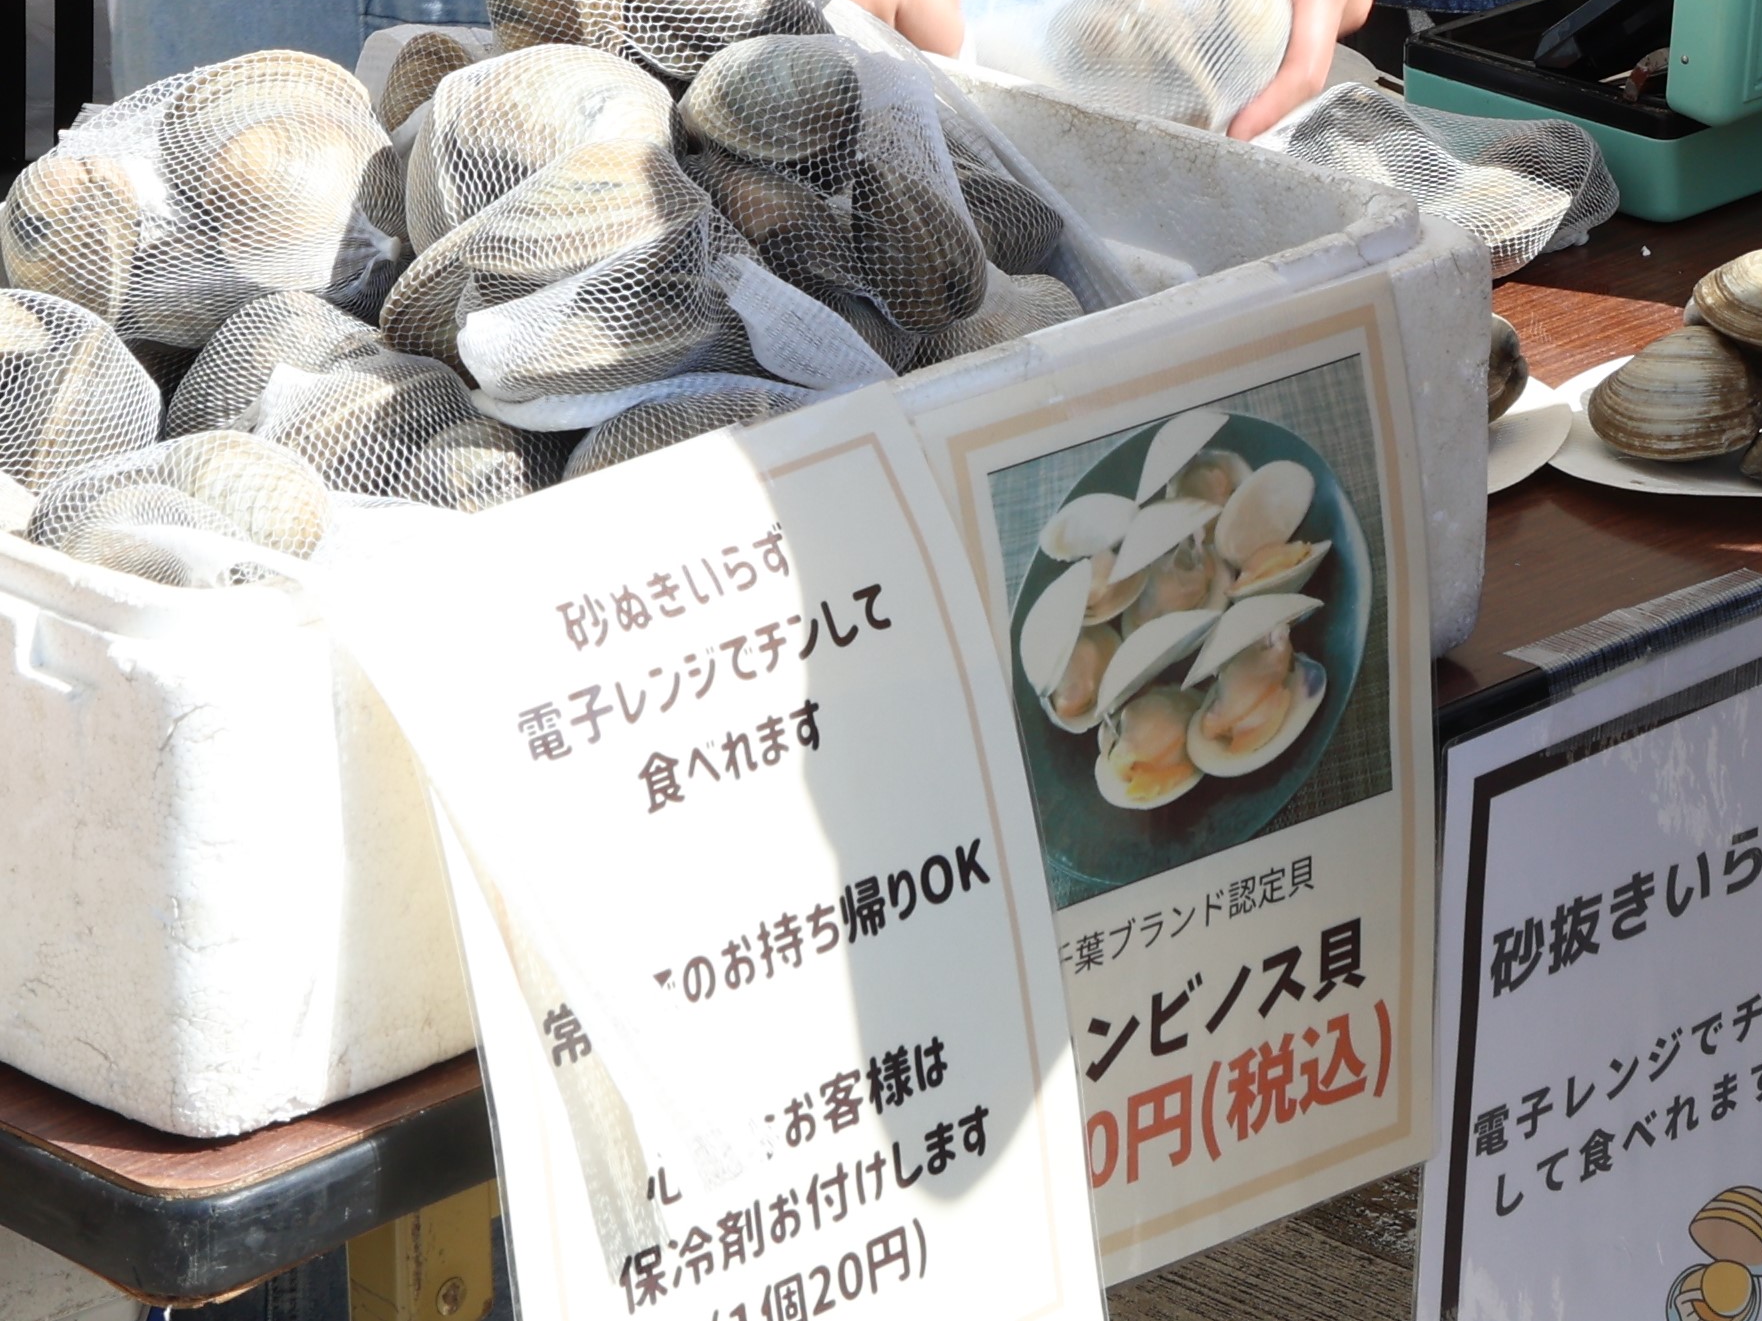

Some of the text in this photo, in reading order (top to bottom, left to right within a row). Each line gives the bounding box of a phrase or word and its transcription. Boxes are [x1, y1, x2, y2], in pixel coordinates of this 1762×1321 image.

[555, 524, 794, 651] 砂ぬきいらず
[517, 584, 892, 762] 電子レンジでチンして
[637, 699, 821, 814] 食べれます
[618, 1105, 989, 1315] 保冷剤お付けします
[711, 1217, 928, 1321] 個20円)
